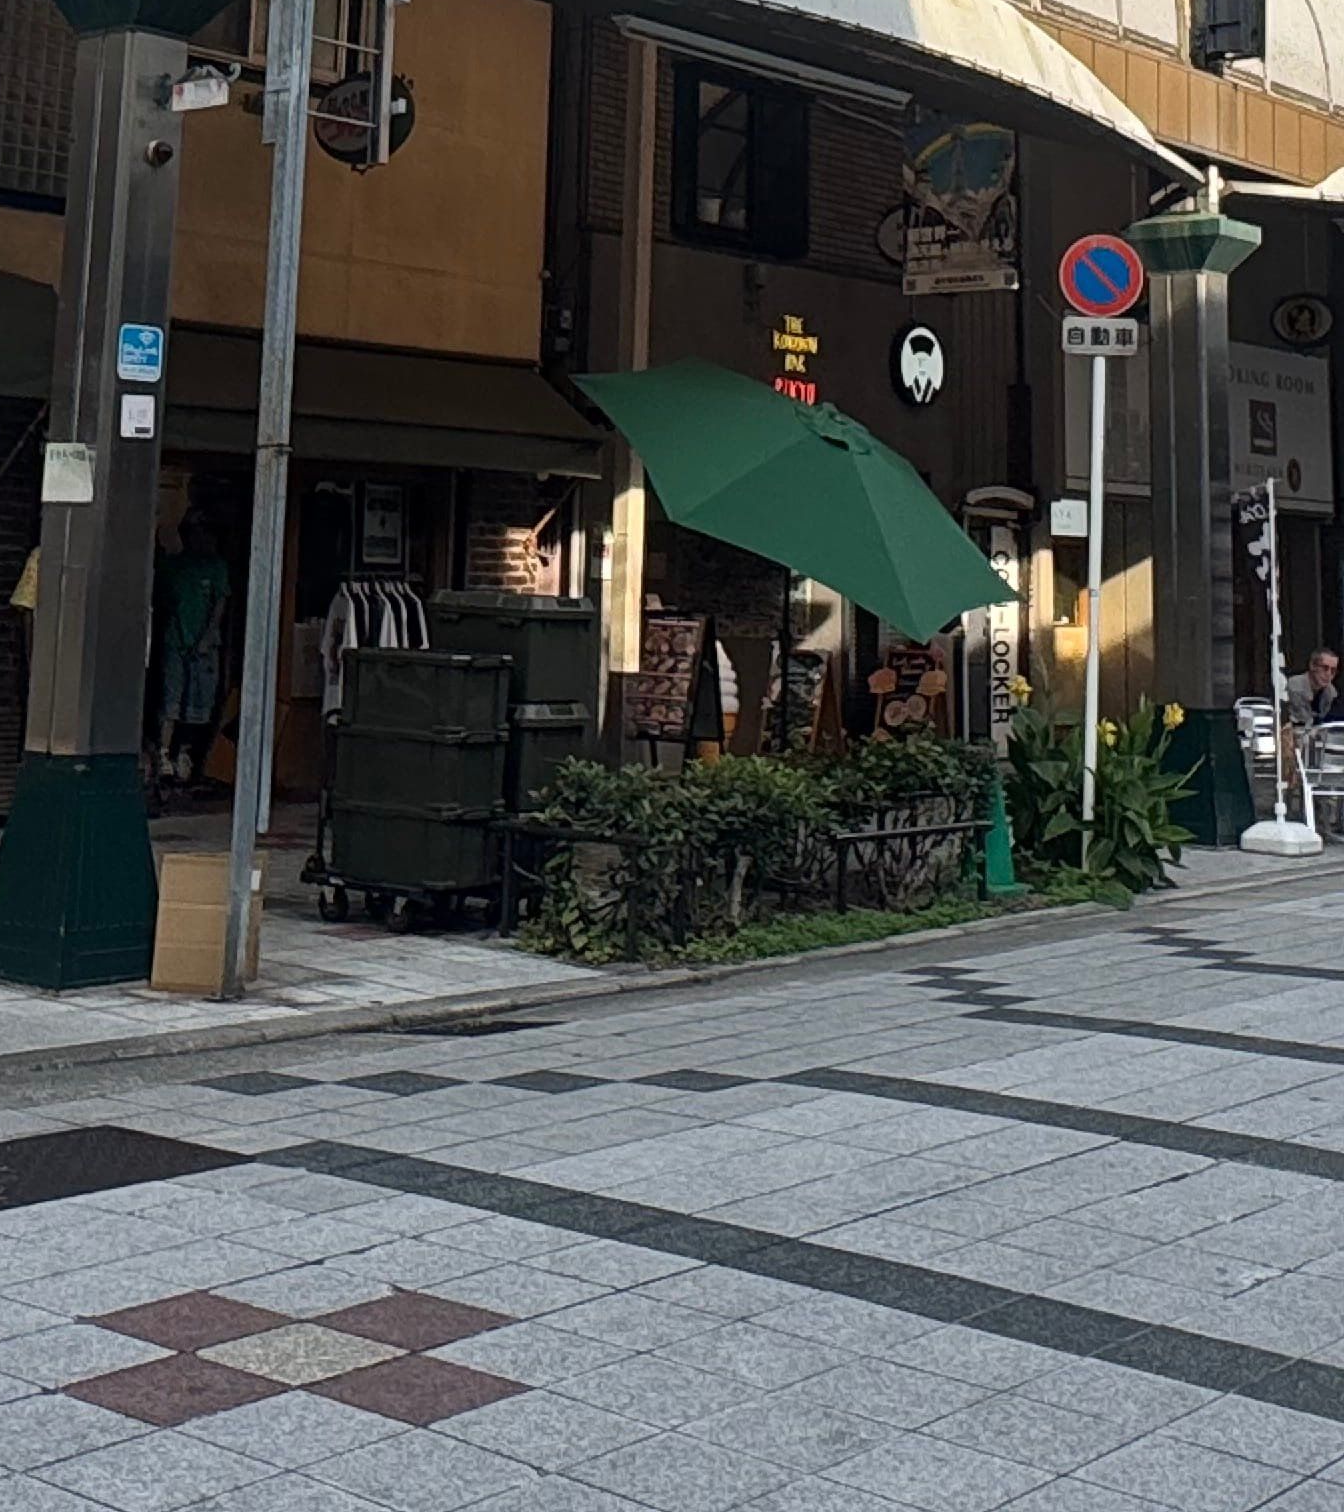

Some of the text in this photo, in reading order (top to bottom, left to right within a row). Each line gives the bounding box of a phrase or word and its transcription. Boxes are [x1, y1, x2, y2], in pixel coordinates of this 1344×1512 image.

[1067, 326, 1134, 348] 自動車
[992, 549, 1010, 725] CO-LOCKER
